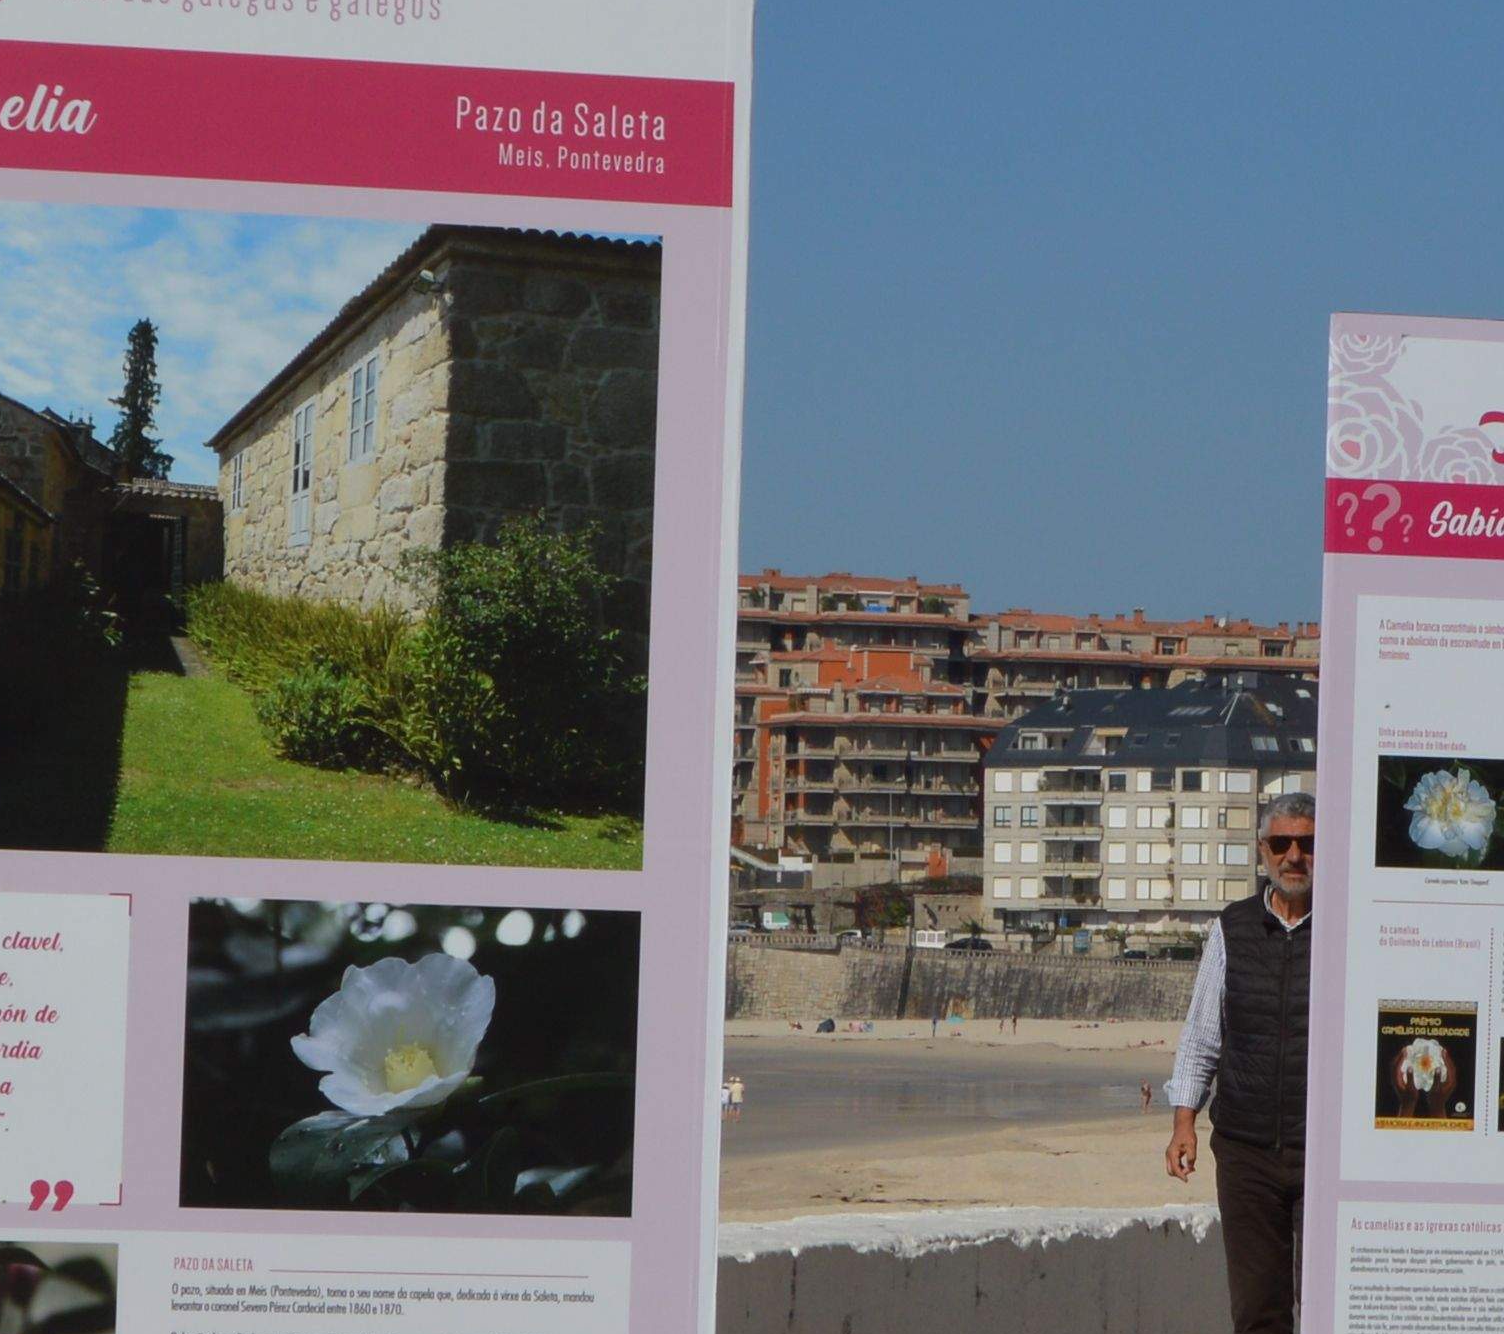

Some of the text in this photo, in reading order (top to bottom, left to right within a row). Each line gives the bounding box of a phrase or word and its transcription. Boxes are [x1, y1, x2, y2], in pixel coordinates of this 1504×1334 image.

[456, 96, 665, 140] Pazo da Saleta
[499, 143, 664, 174] Meis, Pontevedra
[35, 1005, 57, 1023] de
[0, 1081, 11, 1095] a
[174, 1257, 253, 1272] PAZO DA SALETA
